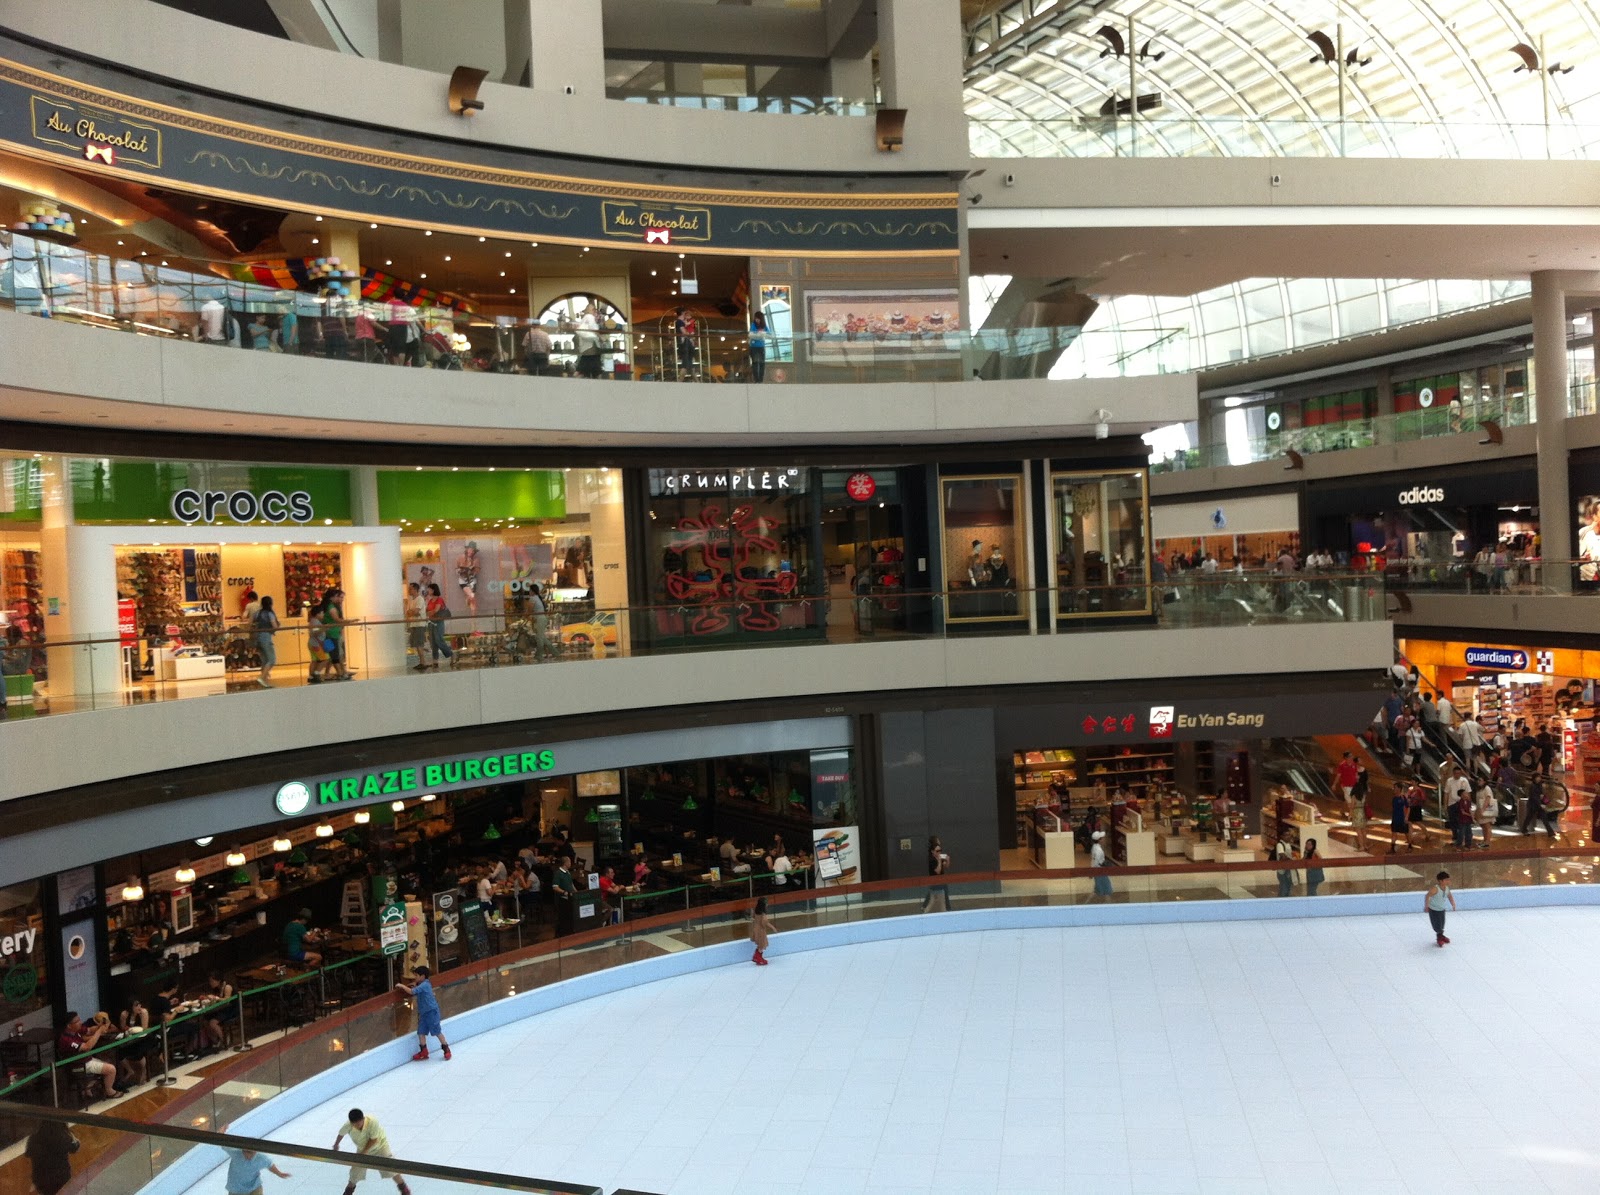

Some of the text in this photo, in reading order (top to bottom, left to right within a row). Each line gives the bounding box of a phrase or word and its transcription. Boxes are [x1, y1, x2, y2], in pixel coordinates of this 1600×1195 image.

[47, 111, 72, 133] Au
[76, 119, 148, 153] Chocolat
[615, 213, 699, 231] Au Chocolat
[1398, 486, 1445, 505] adidas
[172, 489, 313, 523] crocs
[227, 577, 255, 586] crocs
[1467, 651, 1512, 666] guardian
[1177, 712, 1265, 729] Eu Yan Sang
[318, 749, 556, 805] KRAZE BURGERS
[0, 927, 37, 958] ery
